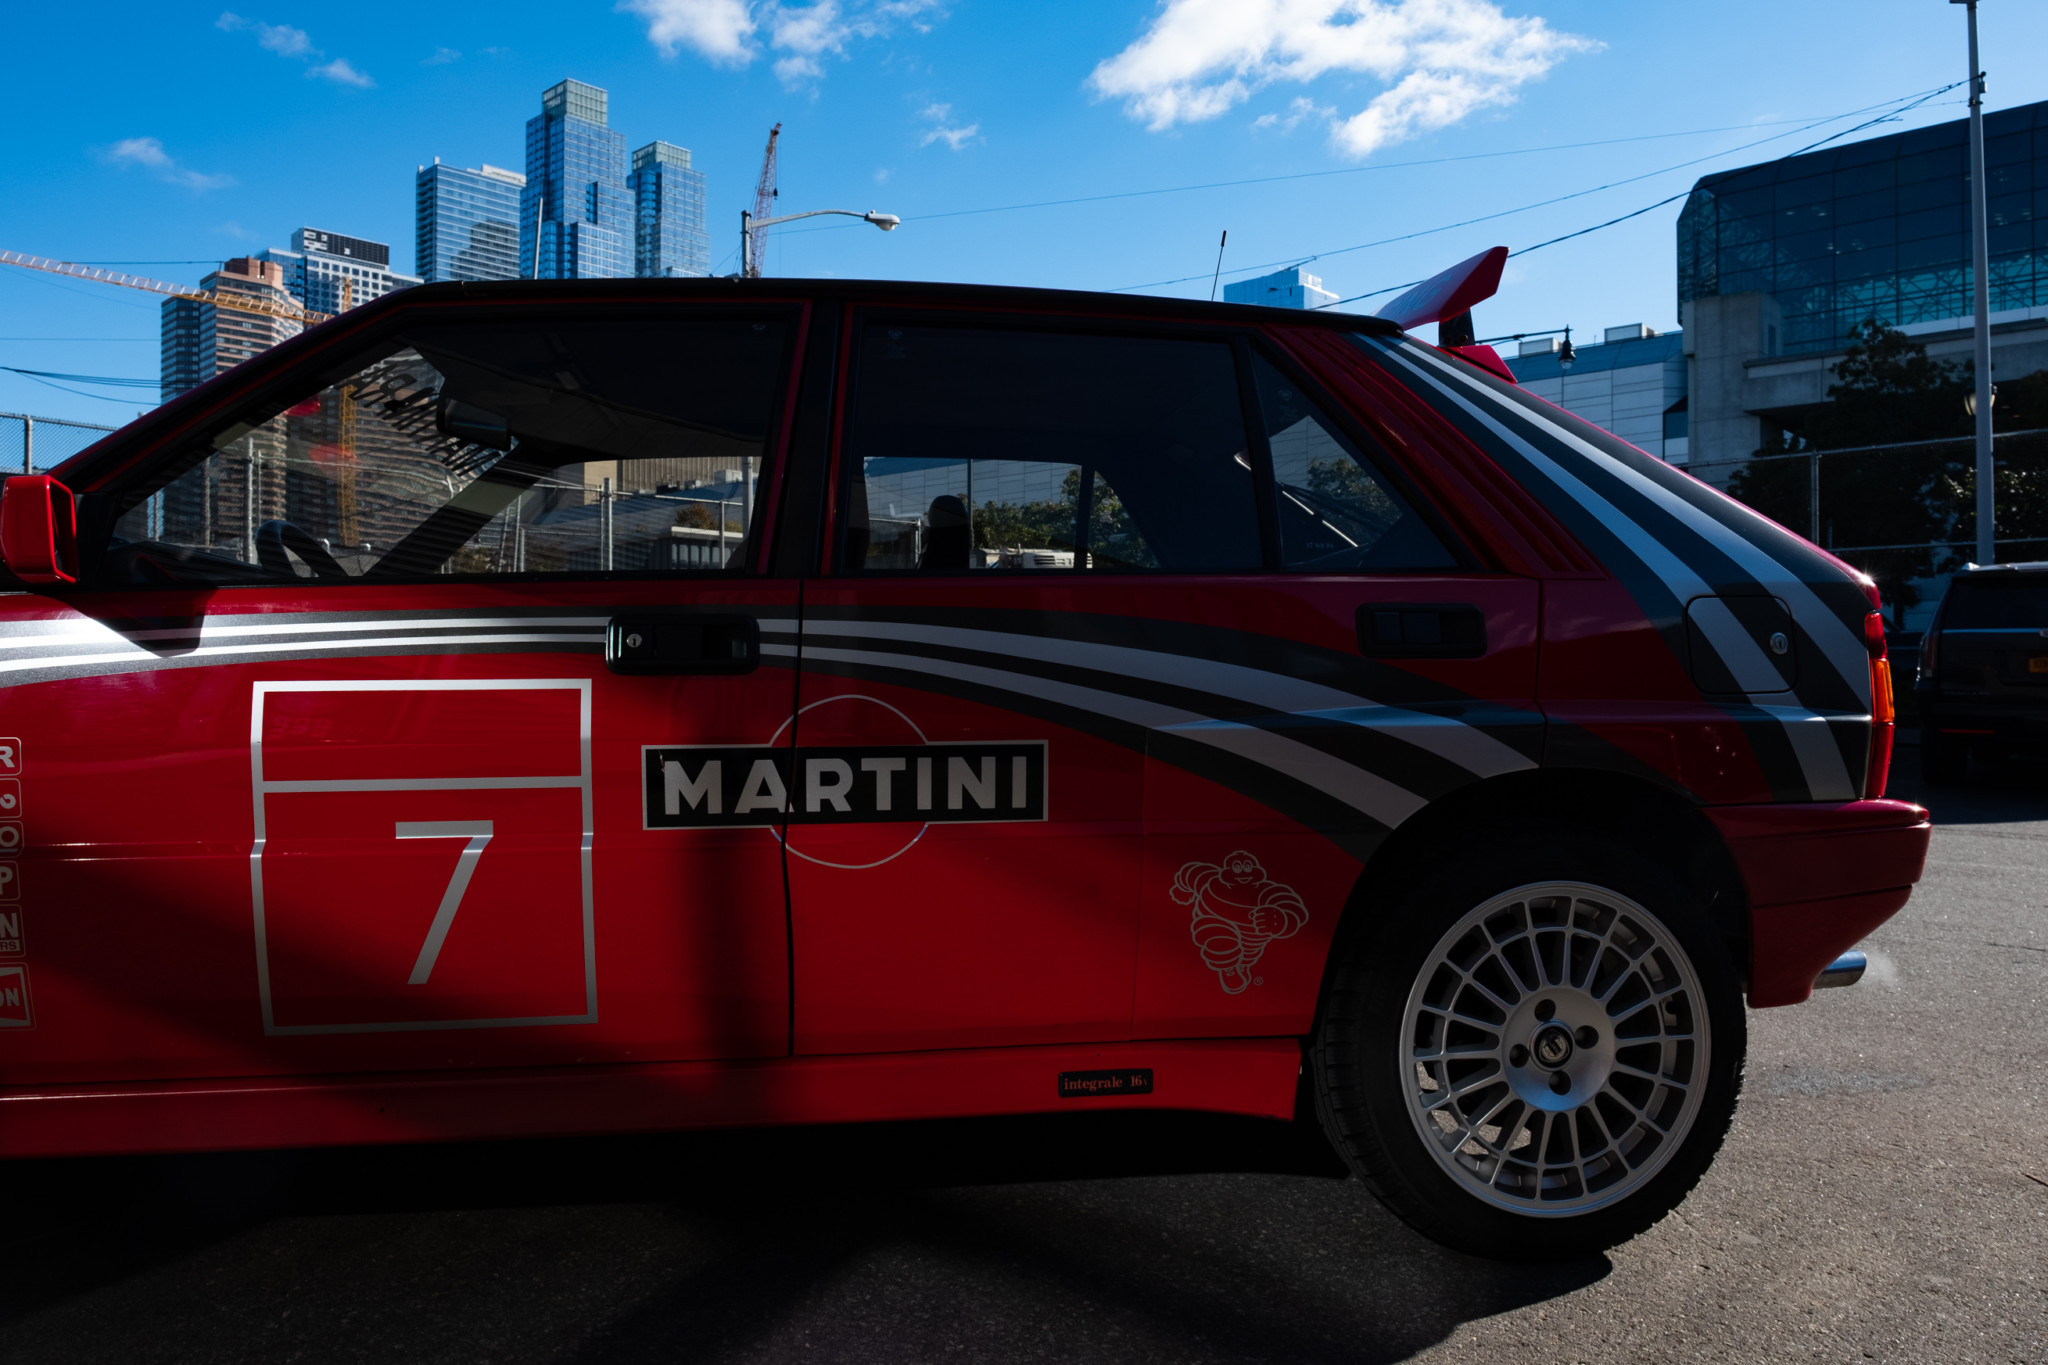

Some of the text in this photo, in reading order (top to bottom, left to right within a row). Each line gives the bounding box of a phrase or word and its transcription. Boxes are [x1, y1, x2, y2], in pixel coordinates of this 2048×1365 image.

[663, 756, 1027, 815] MARTINI
[395, 820, 494, 985] 7
[1064, 1075, 1123, 1092] integrale
